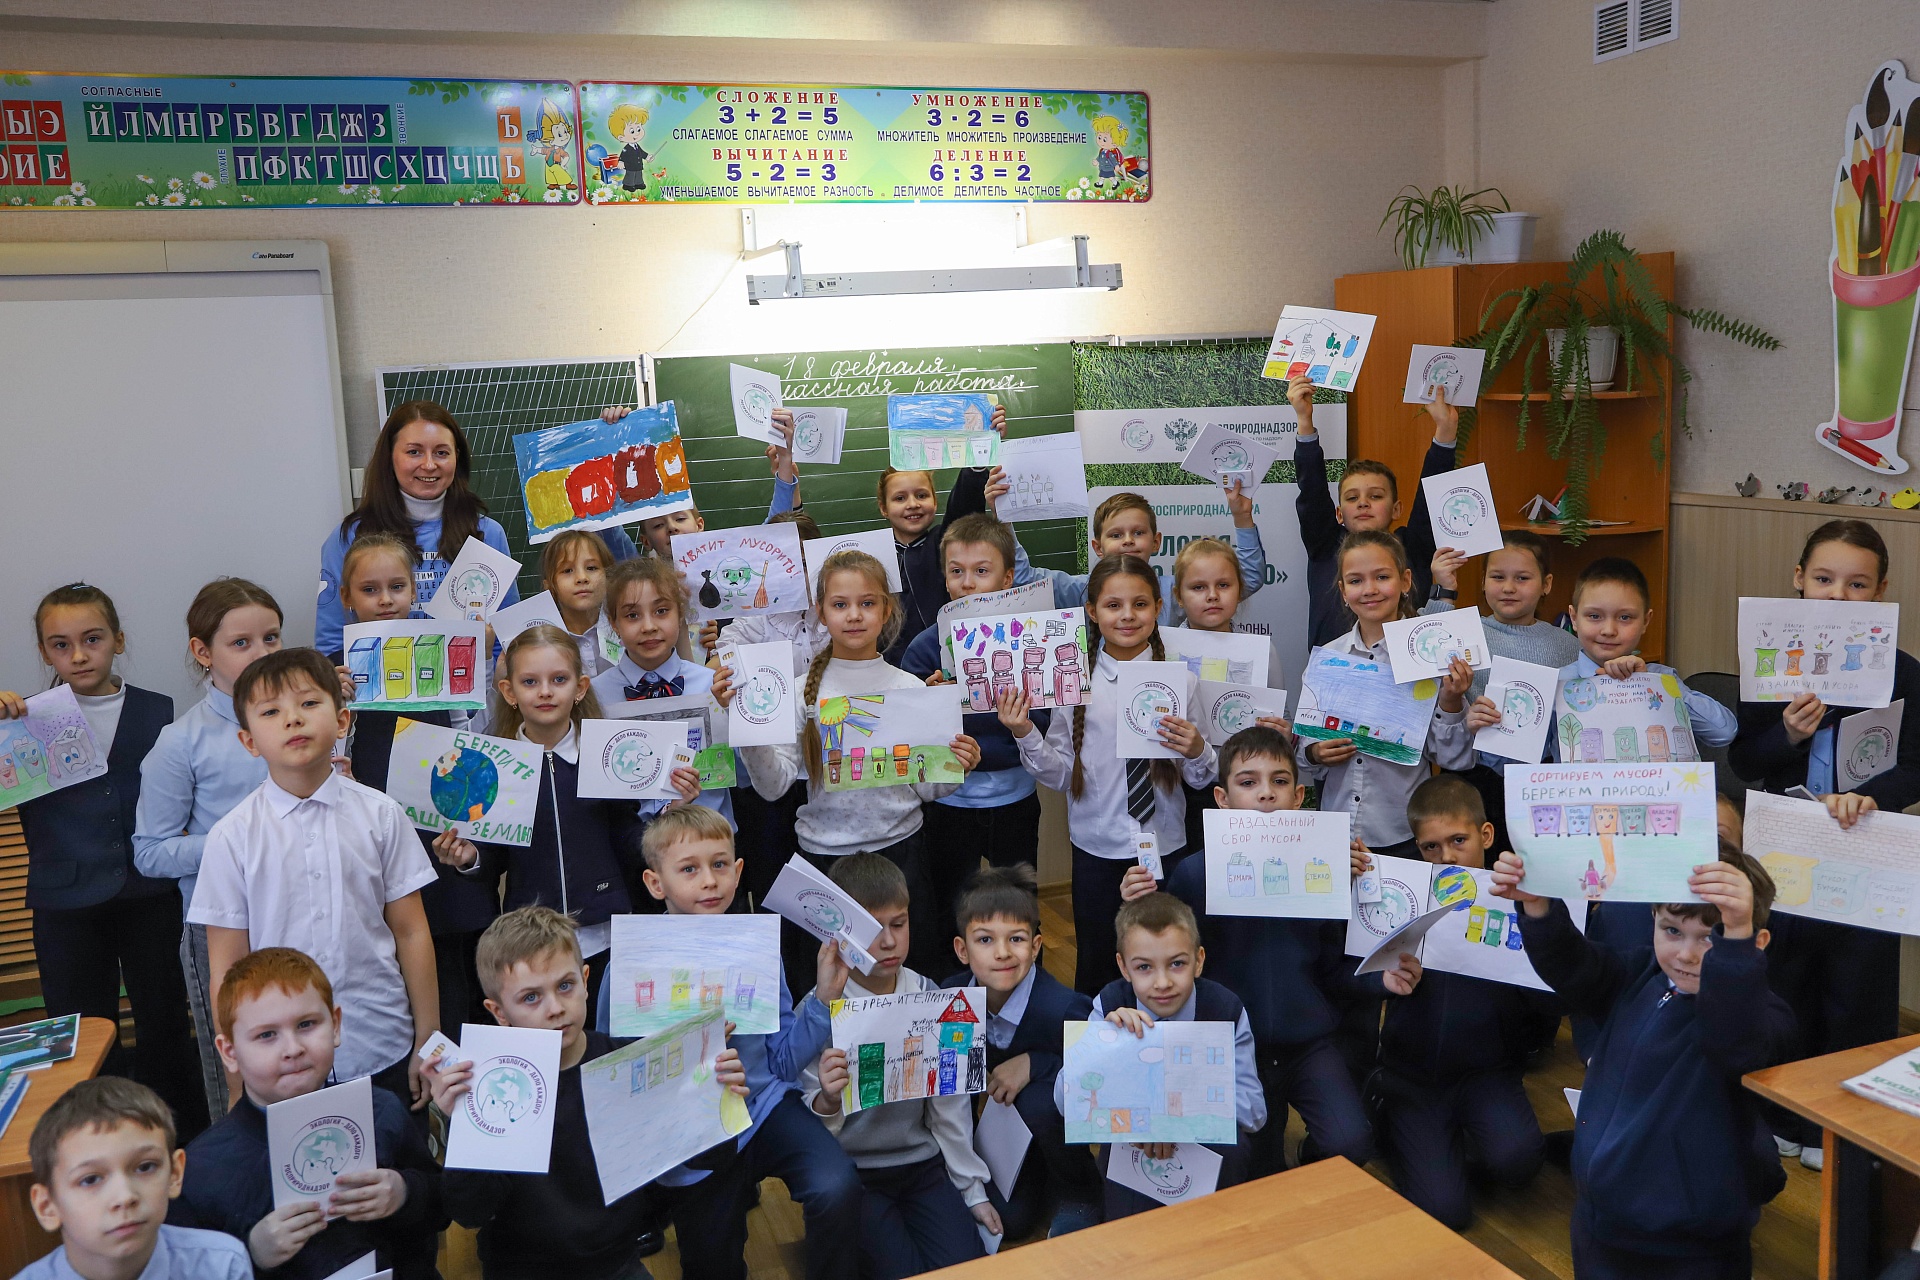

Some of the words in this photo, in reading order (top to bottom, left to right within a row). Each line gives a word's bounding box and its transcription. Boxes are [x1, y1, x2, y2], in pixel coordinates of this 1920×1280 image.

[80, 86, 162, 97] СОГЛАСНЫЕ
[716, 91, 839, 104] СЛОЖЕНИЕ
[912, 94, 1042, 108] УМНОЖЕНИЕ
[718, 105, 735, 124] 3
[771, 106, 787, 125] 2
[823, 107, 838, 125] 5
[927, 108, 942, 126] 3
[968, 110, 982, 127] 2
[1014, 110, 1030, 128] 6
[396, 103, 408, 144] ЗВОНКИЕ
[672, 128, 738, 140] СЛАГАЕМОЕ
[744, 129, 809, 141] СЛАГАЕМОЕ
[817, 130, 854, 142] СУММА
[877, 130, 940, 142] МНОЖИТЕЛЬ
[946, 131, 1008, 143] МНОЖИТЕЛЬ
[1013, 132, 1087, 144] ПРОИЗВЕДЕНИЕ
[712, 148, 848, 160] ВЫЧИТАНИЕ
[933, 150, 1027, 162] ДЕЛЕНИЕ
[217, 149, 228, 184] ГЛУХИЕ
[726, 164, 742, 182] 5
[770, 164, 785, 182] 2
[821, 164, 837, 182] 3
[930, 164, 944, 182] 6
[970, 164, 984, 182] 3
[1017, 164, 1032, 182] 2
[660, 186, 738, 198] УМЕНЬШАЕМОЕ
[748, 186, 816, 197] ВЫЧИТАЕМОЕ
[824, 186, 874, 197] РАЗНОСТЬ
[894, 186, 944, 198] ДЕЛИМОЕ
[954, 186, 1008, 198] ДЕЛИТЕЛЬ
[1014, 186, 1061, 196] ЧАСТНОЕ
[679, 540, 725, 568] ХВАТИТ
[740, 538, 801, 578] МУСОРИТЬ!
[1600, 678, 1612, 686] ЭТО
[1822, 681, 1859, 691] МУСОРА
[454, 732, 535, 780] БЕРЕГИТЕ
[1530, 771, 1604, 783] СОРТИРУЕМ
[1614, 768, 1663, 779] МУСОР!
[1522, 786, 1592, 801] БЕРЕЖЕМ
[1602, 780, 1670, 798] ПРИРОДУ!
[404, 806, 454, 832] АШУ
[1230, 815, 1315, 830] РАЗДЕЛЬНЫЙ
[1222, 834, 1252, 845] СБОР
[1261, 834, 1302, 844] МУСОРА
[498, 1058, 528, 1070] ЭКОЛОГИЯ
[529, 1072, 542, 1086] ДЕЛО
[532, 1086, 543, 1115] КАЖДОГО
[467, 1091, 506, 1134] РОСПРИРОДНАДЗОР
[310, 1118, 342, 1130] ЭКОЛОГИЯ
[344, 1122, 357, 1134] ДЕЛО
[353, 1134, 362, 1160] КАЖДОГО
[284, 1164, 330, 1192] РОСПРИРОДНАДЗОР
